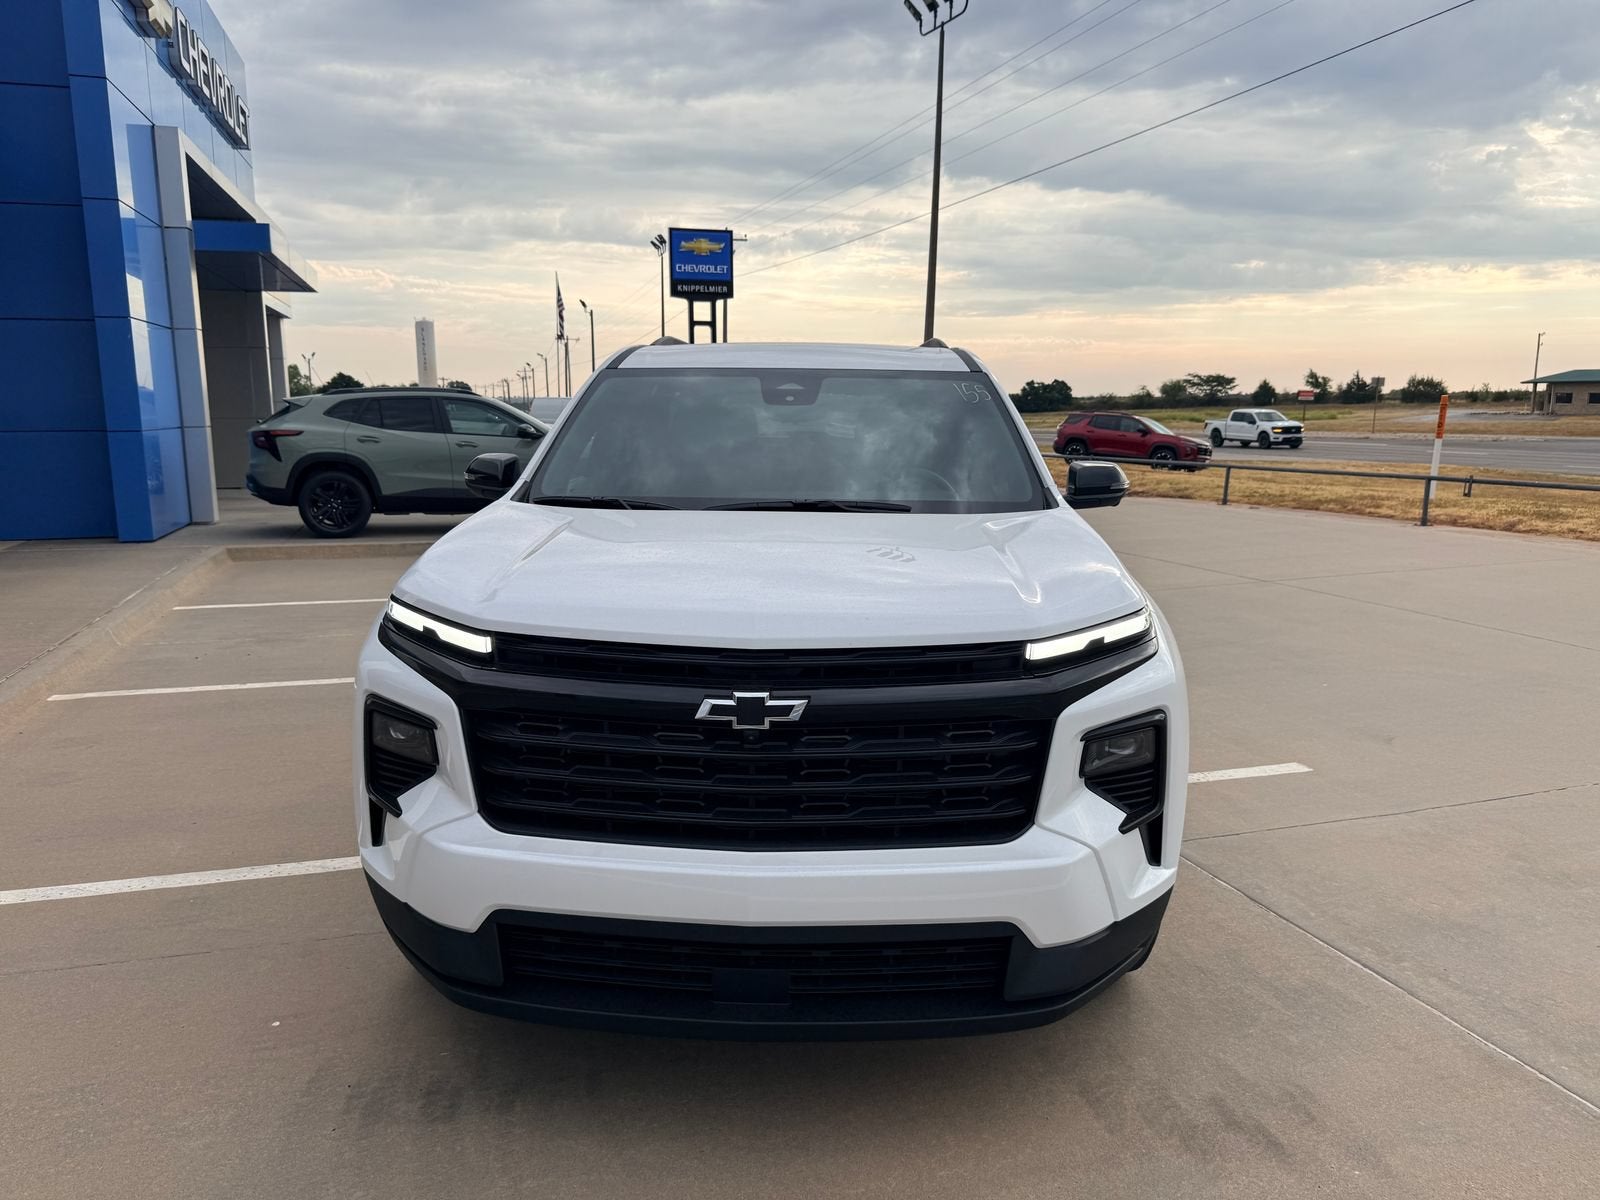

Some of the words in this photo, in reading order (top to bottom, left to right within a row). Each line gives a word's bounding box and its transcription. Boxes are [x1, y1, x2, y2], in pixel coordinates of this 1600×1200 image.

[175, 7, 249, 147] CHEVROLET
[675, 263, 728, 274] CHEVROLET
[677, 284, 728, 293] KNIPPELMIER
[952, 382, 992, 403] 155
